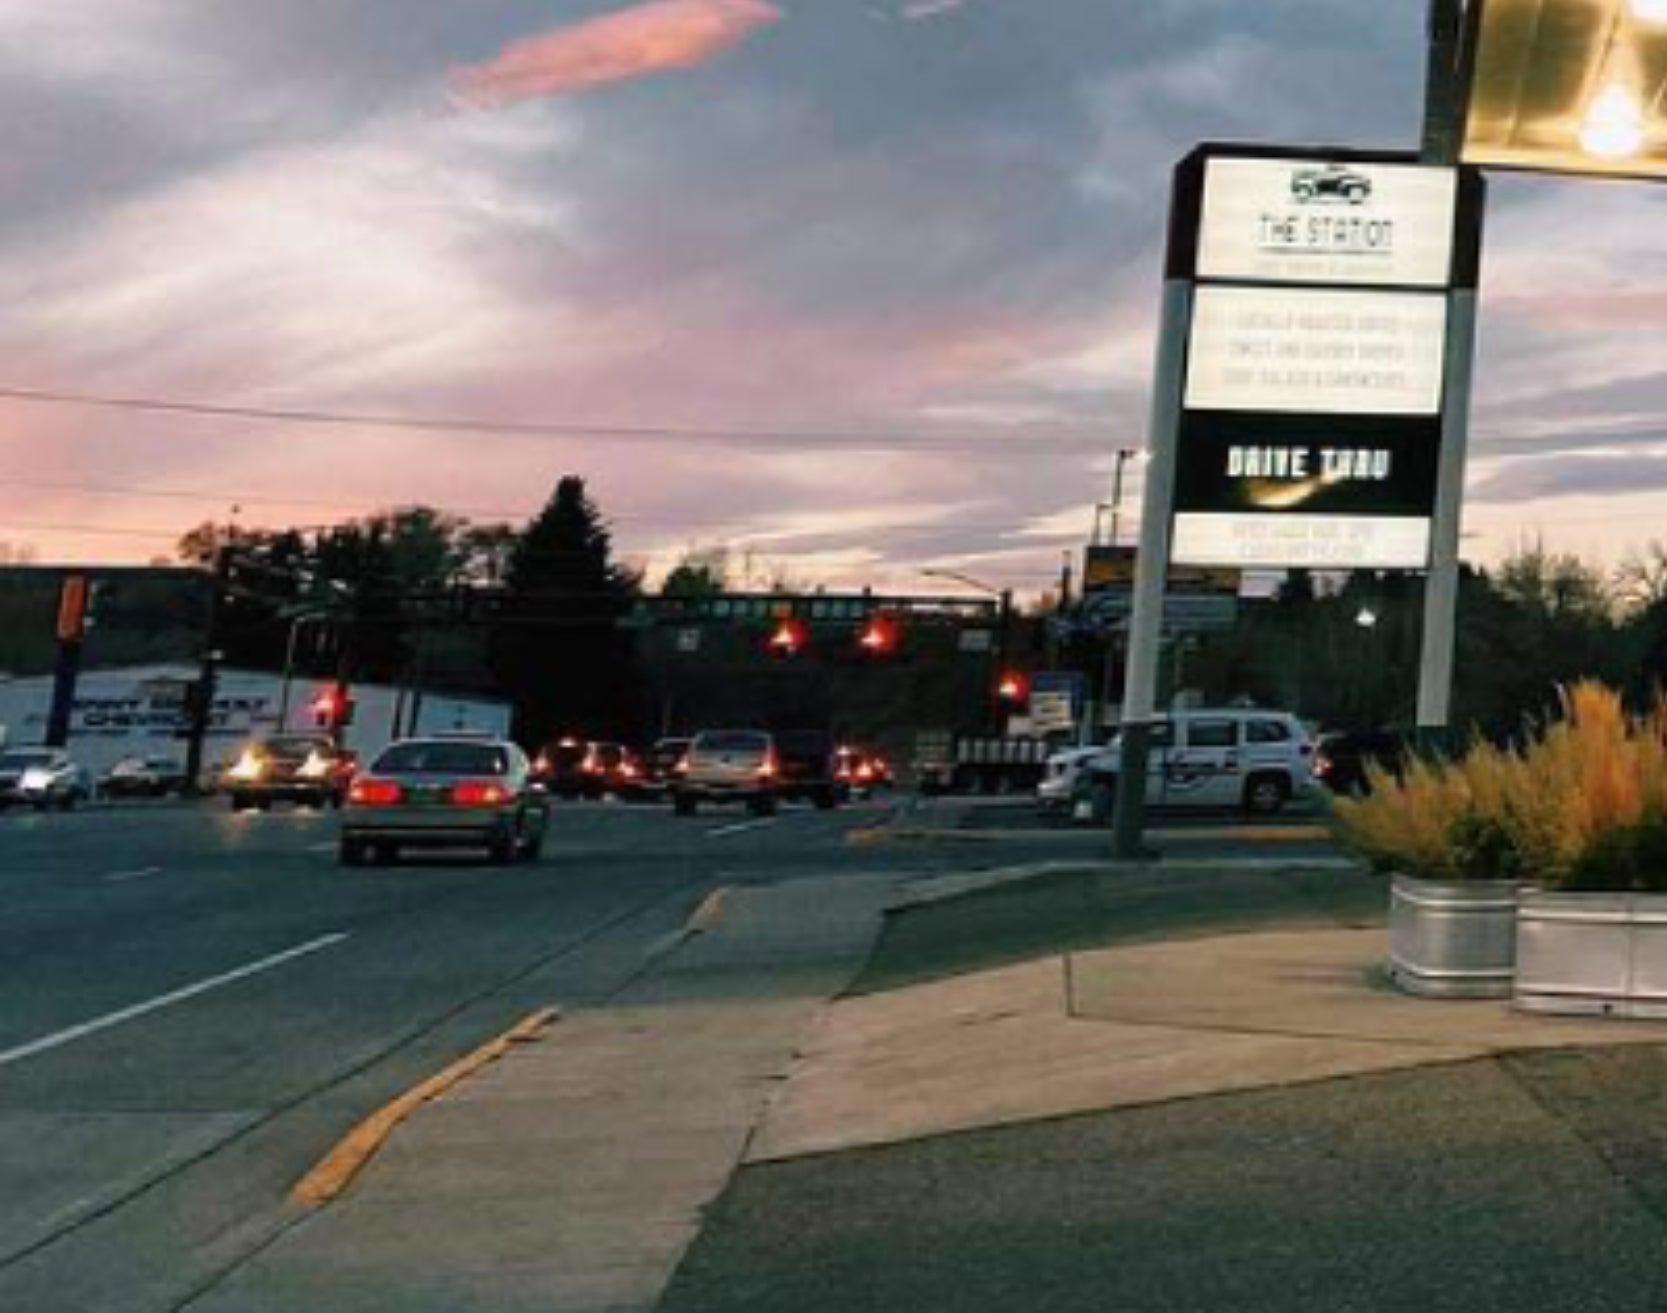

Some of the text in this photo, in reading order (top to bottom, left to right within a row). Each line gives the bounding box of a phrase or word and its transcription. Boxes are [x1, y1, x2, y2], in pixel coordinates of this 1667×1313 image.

[1259, 214, 1393, 248] THE STATION
[1227, 445, 1390, 479] DRIVE THRU
